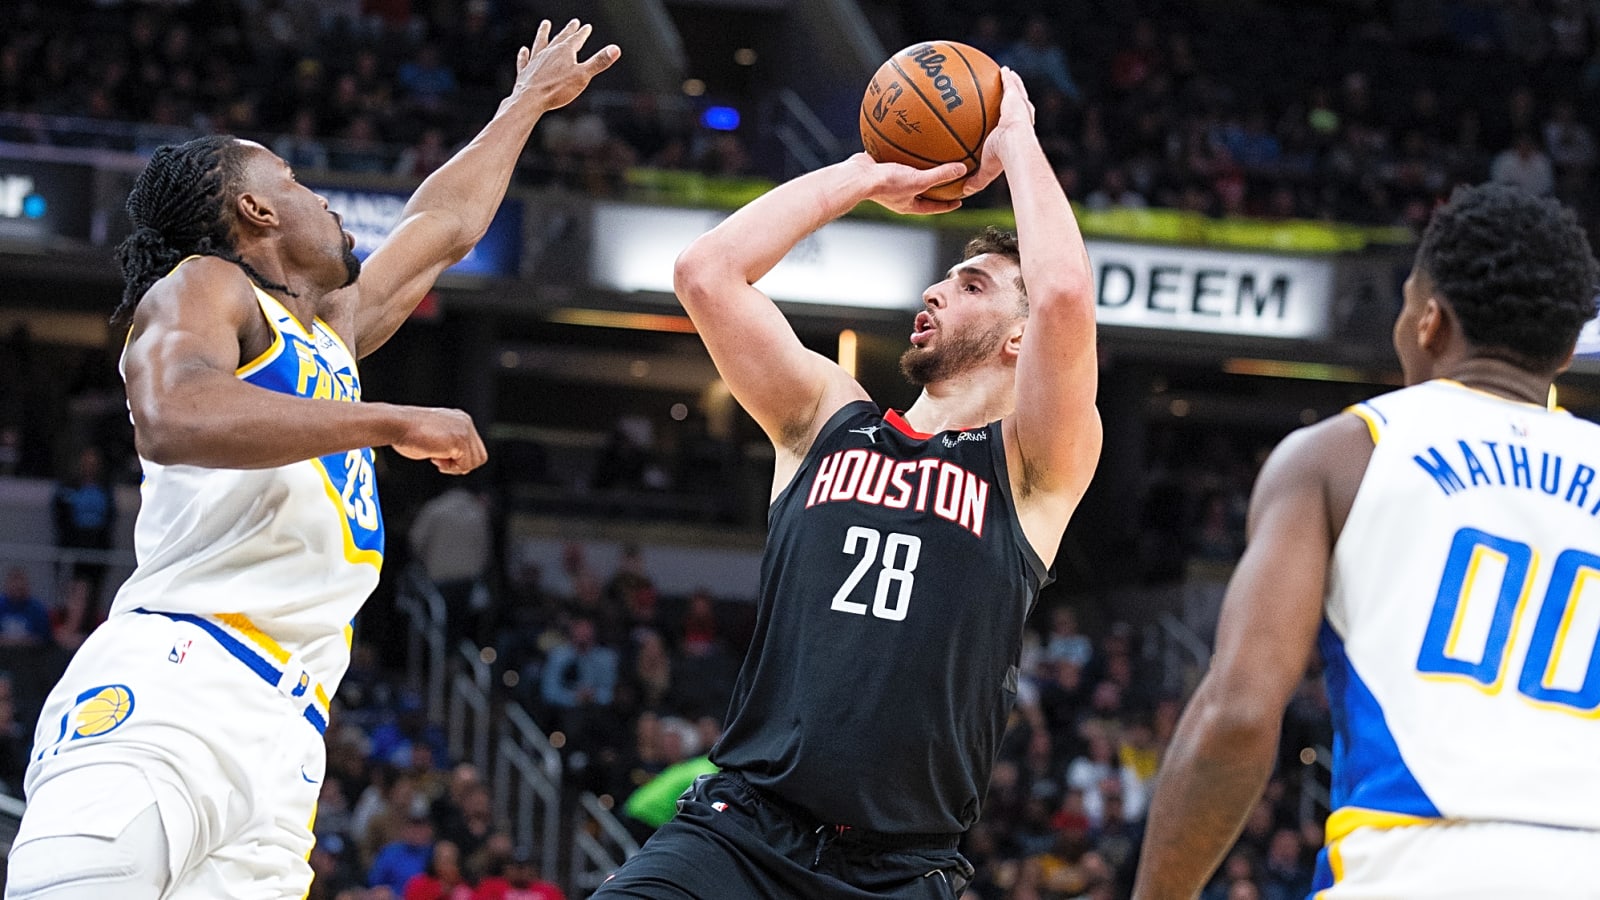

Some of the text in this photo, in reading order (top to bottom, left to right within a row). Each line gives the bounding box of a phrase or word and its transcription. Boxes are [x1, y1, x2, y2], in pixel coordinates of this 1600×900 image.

[341, 449, 378, 531] 23
[805, 449, 989, 538] HOUSTON
[1412, 440, 1600, 516] MATHUR
[830, 526, 922, 621] 28
[1415, 526, 1600, 719] 00
